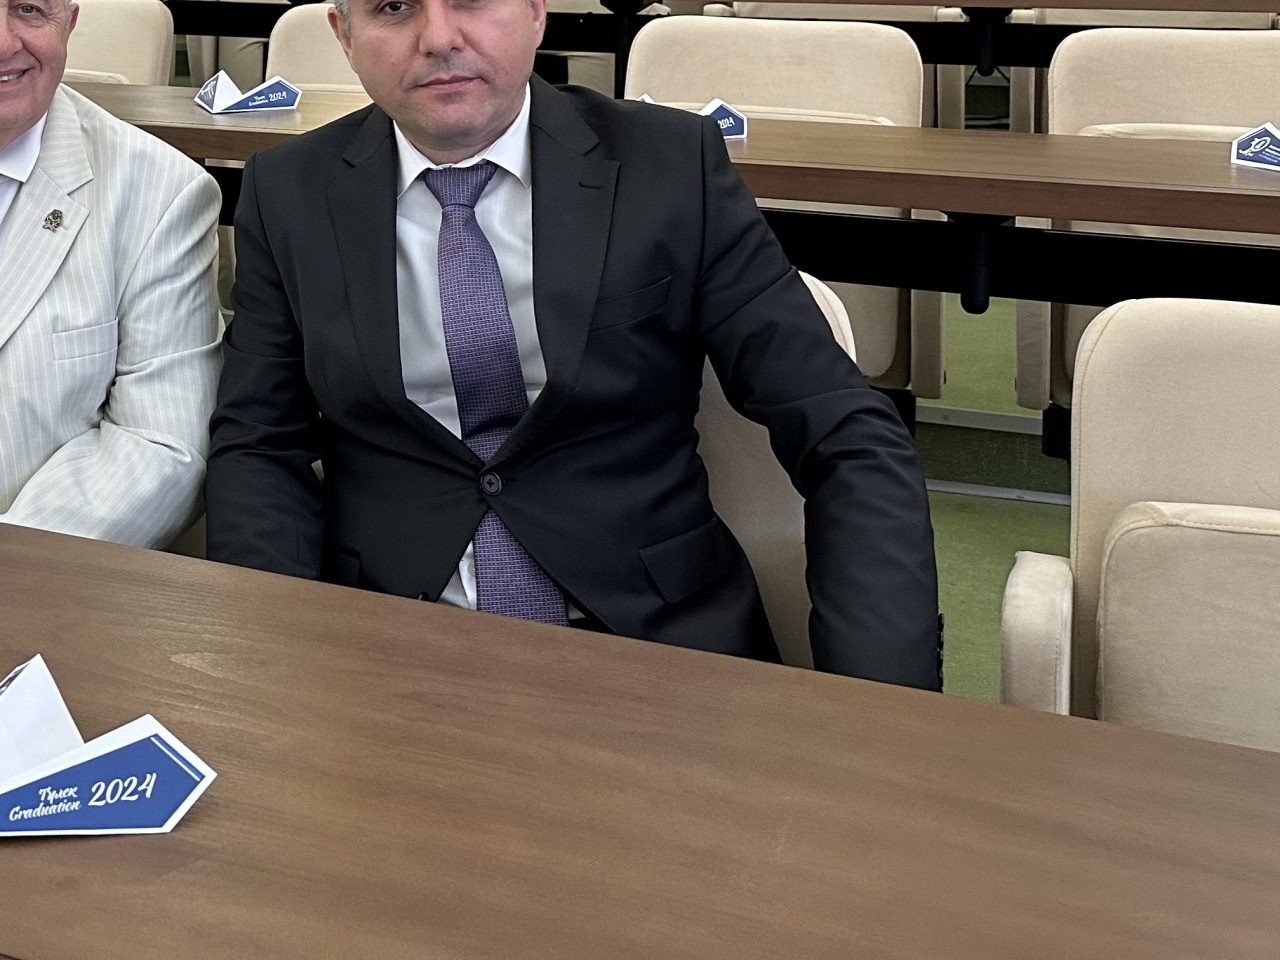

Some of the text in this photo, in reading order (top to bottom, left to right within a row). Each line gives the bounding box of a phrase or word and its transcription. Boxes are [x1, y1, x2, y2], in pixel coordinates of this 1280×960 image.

[268, 91, 287, 101] 2024
[717, 116, 736, 129] 2024
[88, 772, 157, 807] 2024
[9, 799, 82, 821] Graduation
